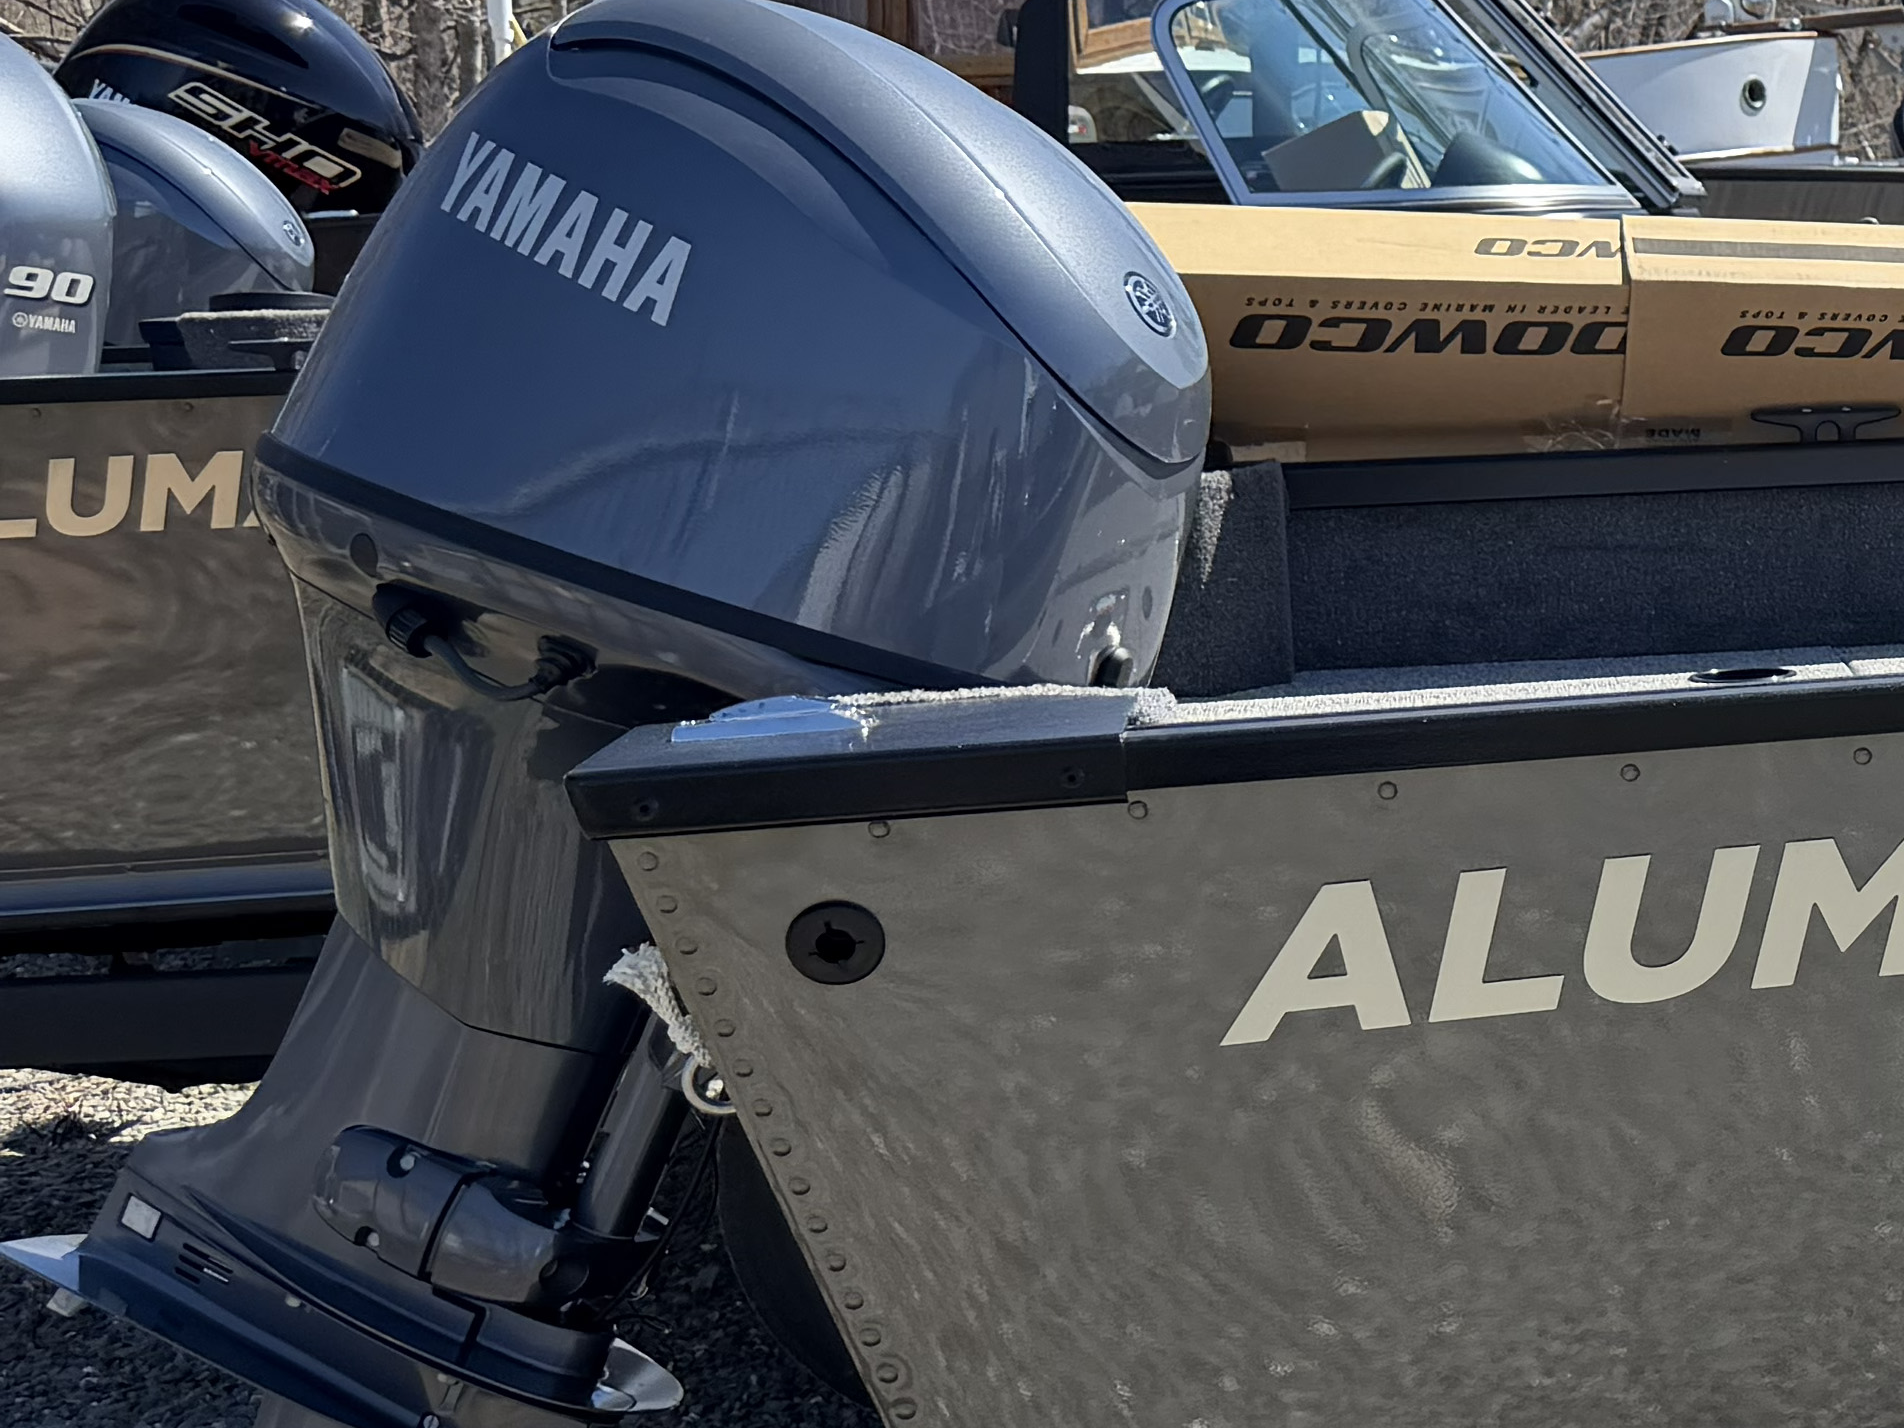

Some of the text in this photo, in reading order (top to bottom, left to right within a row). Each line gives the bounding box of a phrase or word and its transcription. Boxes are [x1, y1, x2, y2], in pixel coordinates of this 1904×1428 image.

[439, 131, 694, 328] YAMAHA
[1474, 238, 1621, 258] WCO
[4, 266, 94, 304] 90
[1245, 297, 1296, 309] TOPS
[1308, 299, 1319, 309] &
[1330, 300, 1408, 312] COVERS
[1419, 301, 1496, 314] MARINE
[1505, 303, 1528, 315] IN
[1537, 304, 1611, 316] LEADER
[1739, 310, 1785, 320] TOPS
[1797, 311, 1807, 321] &
[28, 314, 76, 334] YAMAHA
[1817, 313, 1889, 324] COVERS
[1229, 313, 1627, 356] DOWCO
